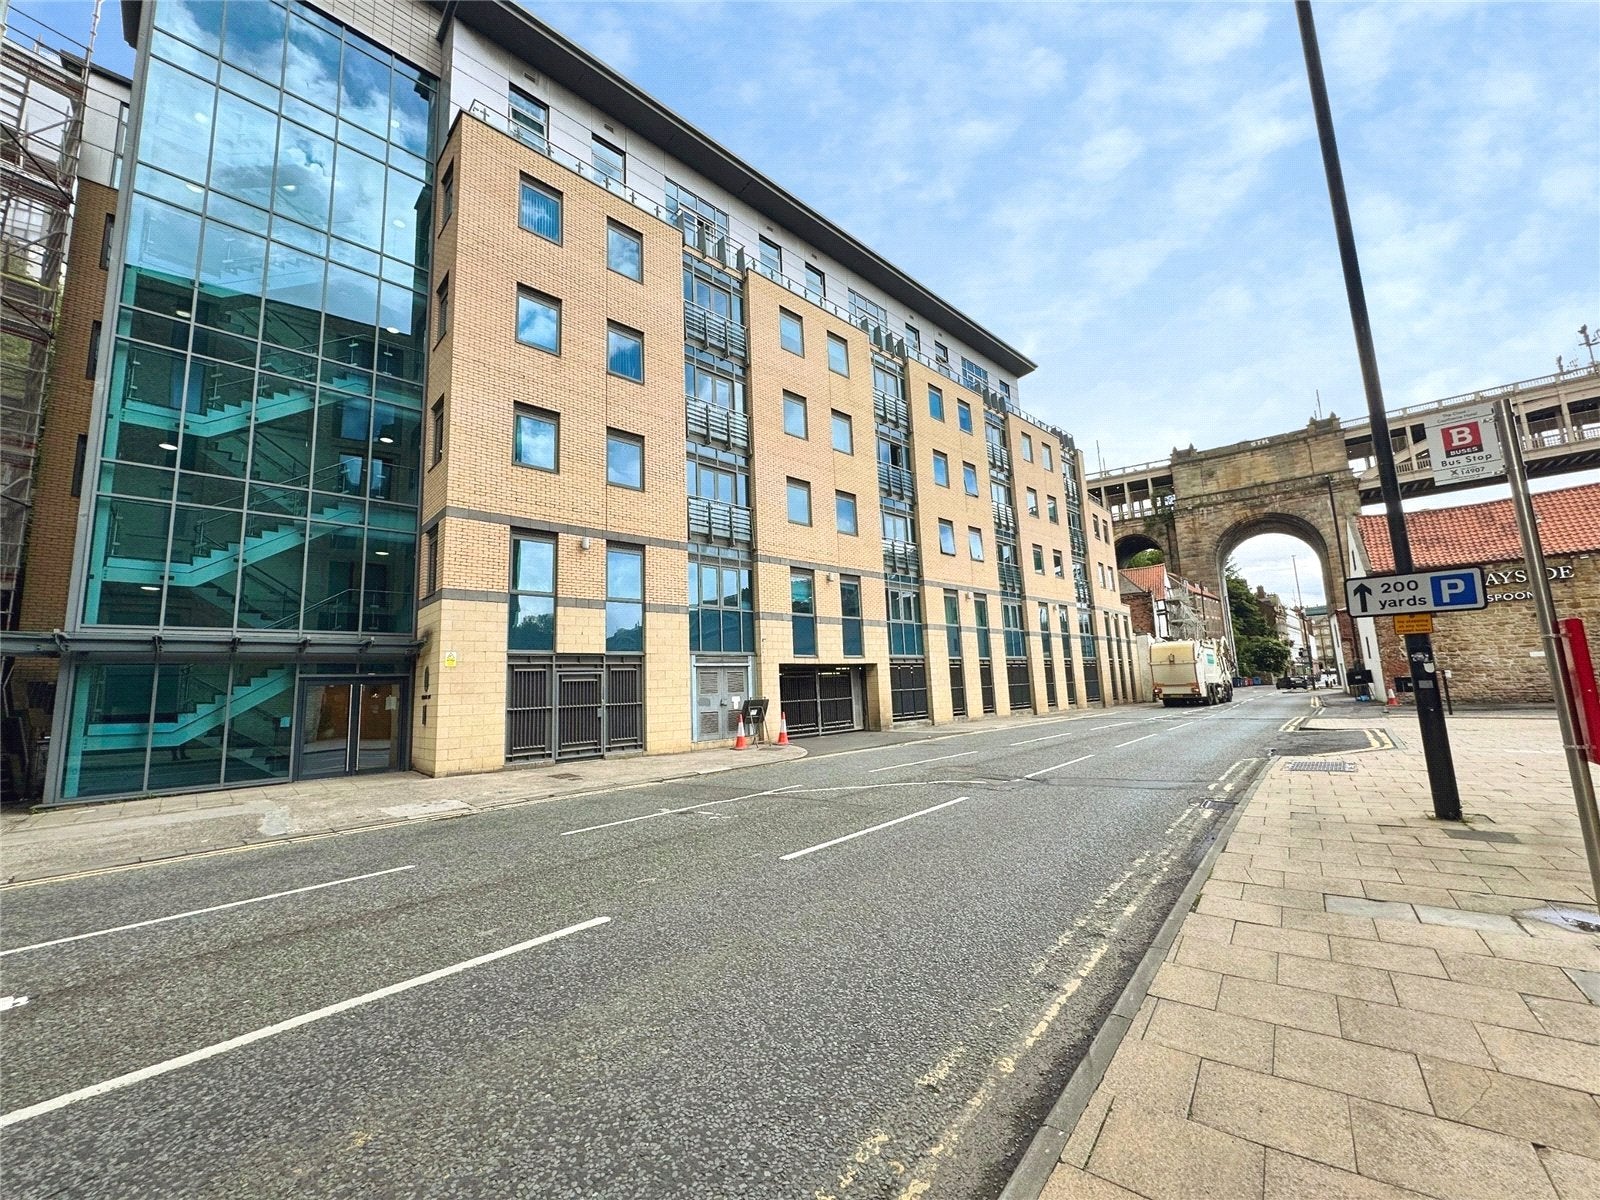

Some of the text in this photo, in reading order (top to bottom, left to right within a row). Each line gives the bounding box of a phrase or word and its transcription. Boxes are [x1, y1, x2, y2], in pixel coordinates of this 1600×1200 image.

[1449, 426, 1473, 447] B
[1450, 446, 1479, 456] BUSES
[1441, 453, 1492, 467] Bus Stop
[1485, 565, 1575, 586] AYSDE
[1380, 580, 1419, 594] 200
[1440, 578, 1465, 603] P
[1378, 595, 1427, 610] yards
[1486, 591, 1534, 602] SPOON
